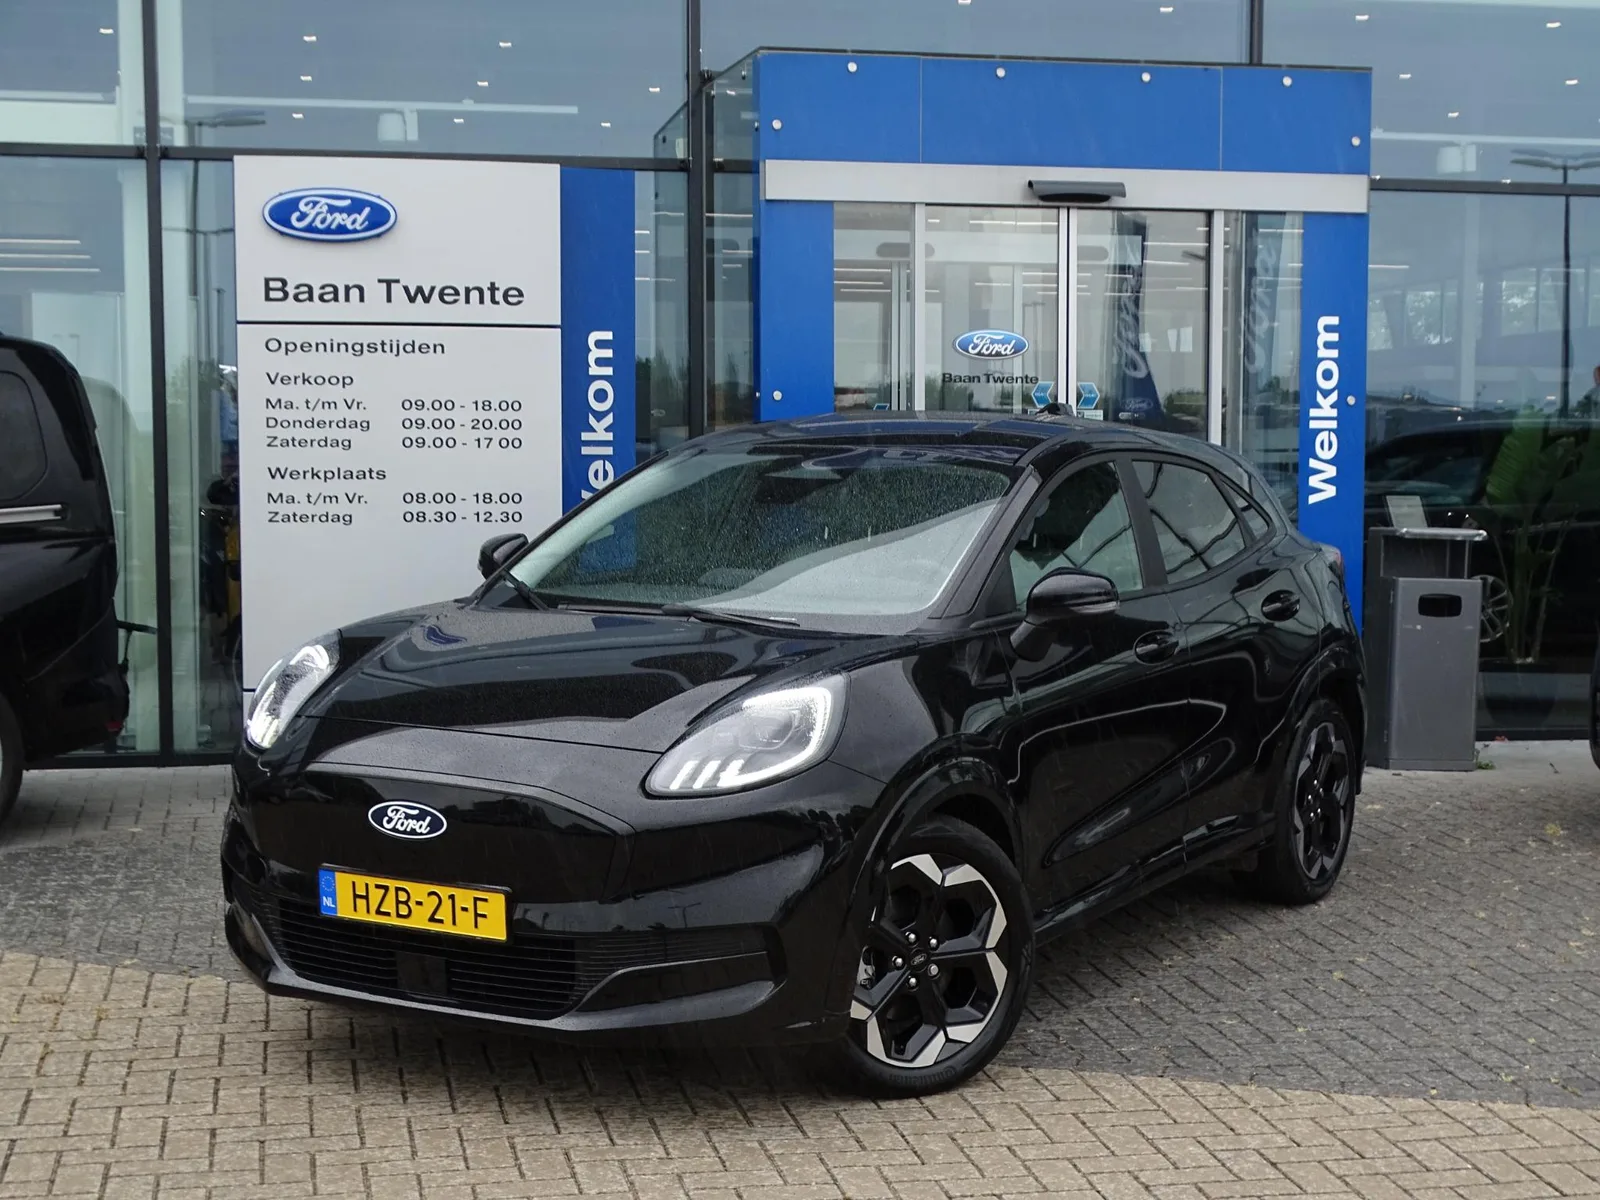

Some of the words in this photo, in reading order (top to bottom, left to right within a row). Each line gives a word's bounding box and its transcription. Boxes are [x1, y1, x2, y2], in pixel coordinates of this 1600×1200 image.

[291, 195, 370, 231] Ford
[263, 276, 366, 304] Baan
[376, 278, 525, 307] Twente
[264, 337, 446, 358] Openingstijden
[968, 333, 1015, 355] Ford
[265, 371, 354, 389] Verkoop
[942, 372, 981, 384] Baan
[983, 373, 1040, 385] Twente
[265, 398, 299, 410] Ma.
[304, 398, 338, 412] t/m
[343, 398, 367, 410] Vr.
[401, 399, 456, 411] 09.00
[472, 399, 522, 412] 18.00
[1308, 315, 1340, 505] Welkom
[580, 330, 614, 500] elkom
[265, 416, 371, 432] Donderdag
[401, 418, 456, 430] 09.00
[470, 418, 523, 430] 20.00
[265, 435, 352, 451] Zaterdag
[401, 436, 457, 449] 09.00
[266, 466, 387, 483] Werkplaats
[266, 492, 301, 505] Ma.
[306, 492, 339, 506] t/m
[344, 492, 368, 505] Vr.
[402, 492, 457, 504] 08.00
[472, 492, 523, 504] 18.00
[267, 511, 353, 526] Zaterdag
[402, 511, 457, 523] 08.30
[473, 511, 523, 523] 12.30
[382, 804, 431, 835] Ford
[322, 895, 336, 908] NL
[350, 879, 489, 930] HZB-21-F
